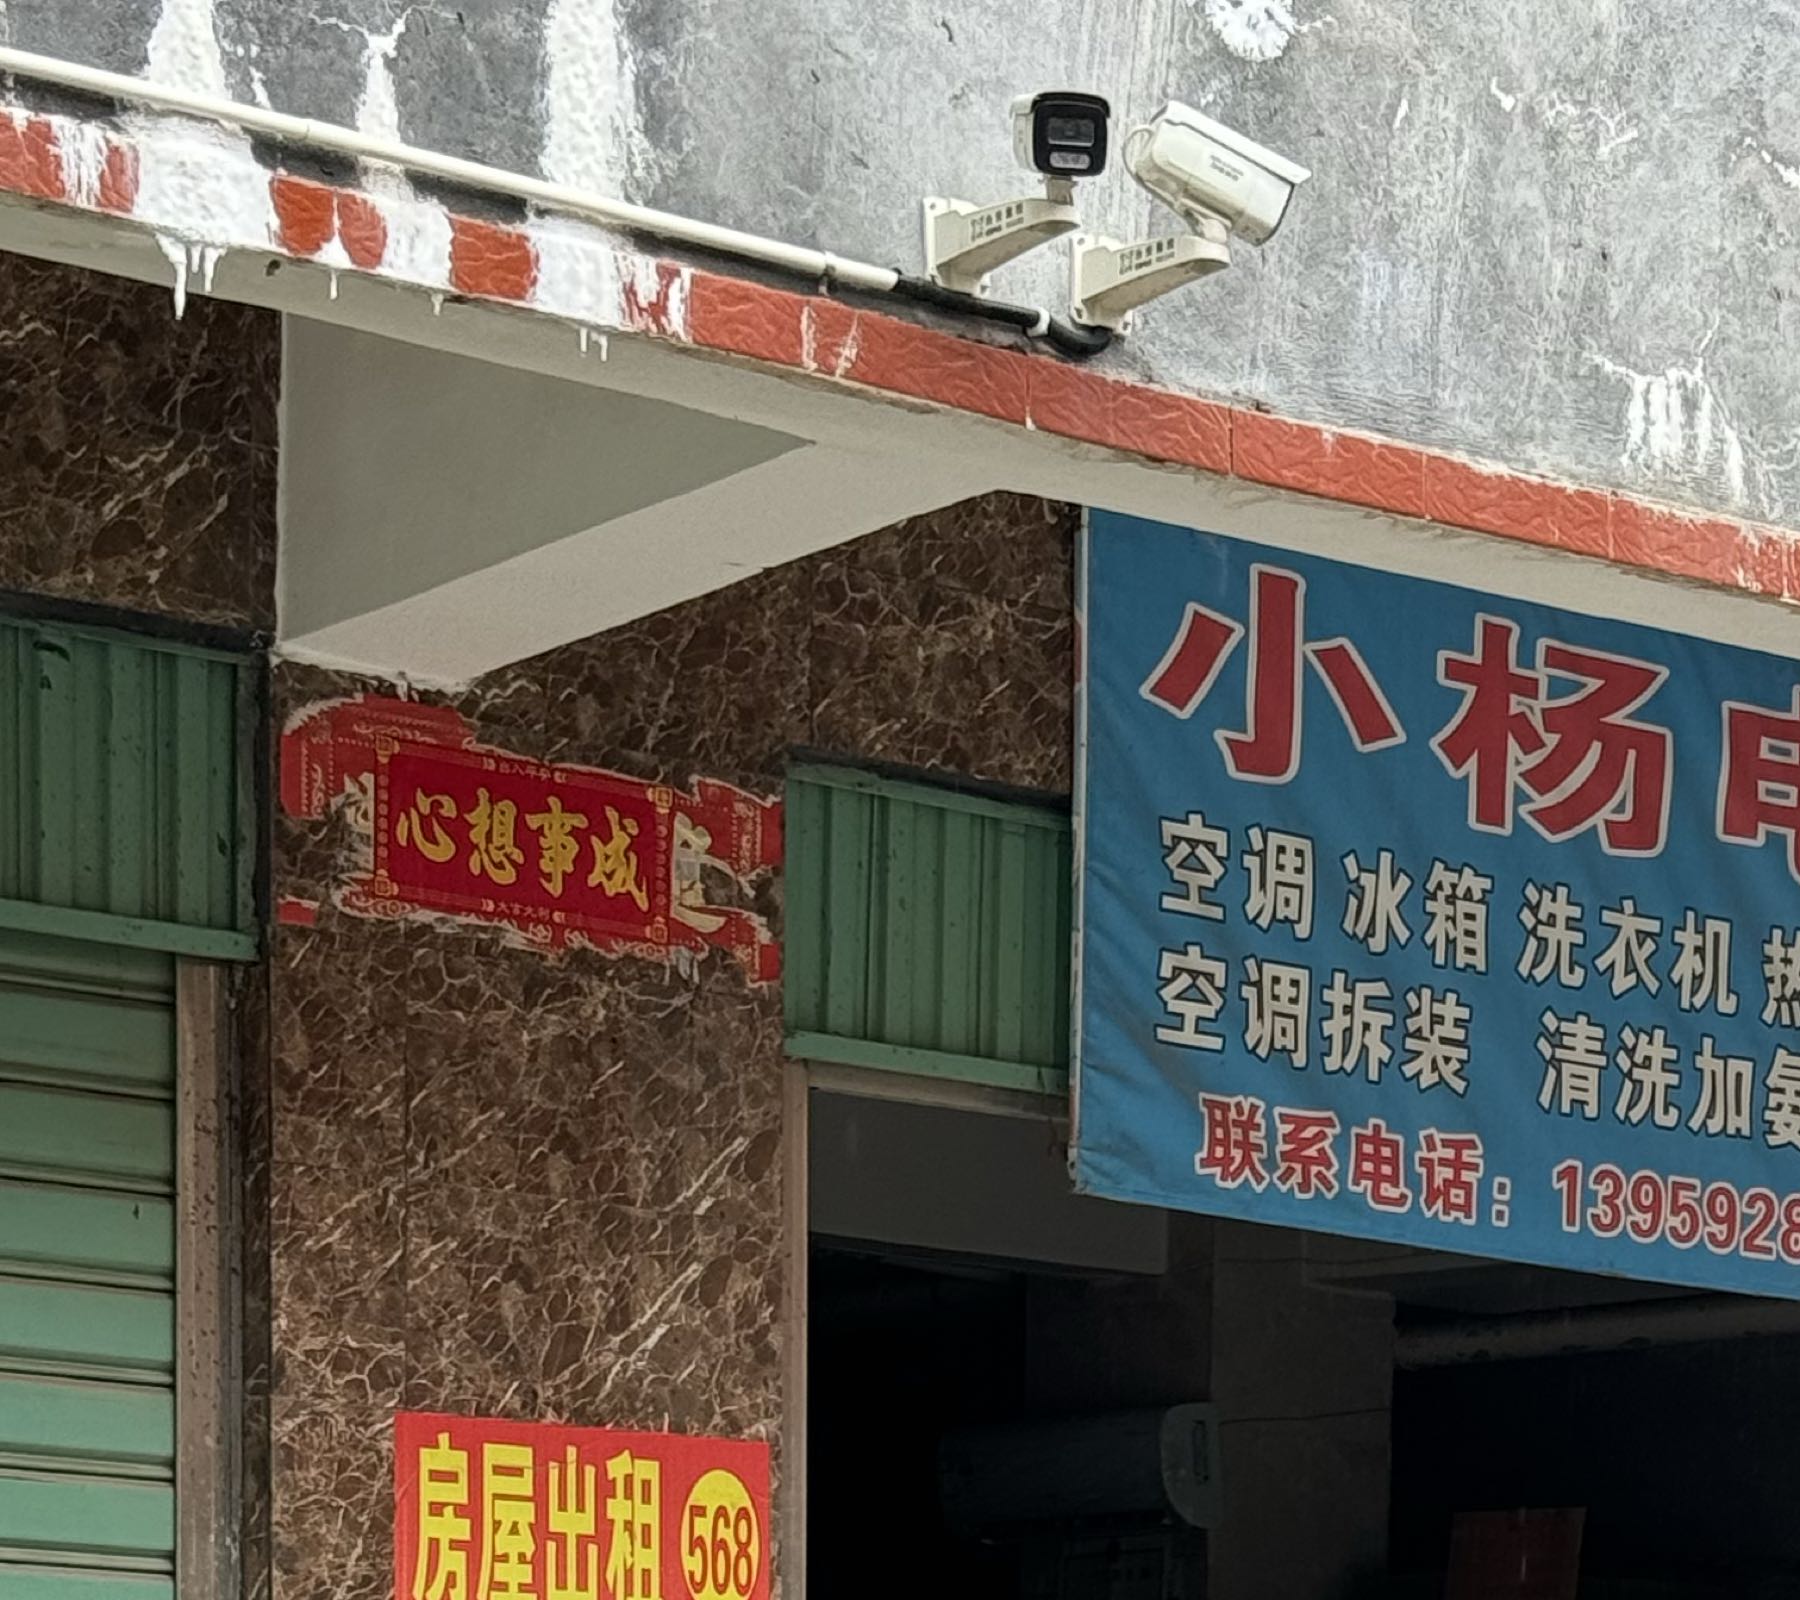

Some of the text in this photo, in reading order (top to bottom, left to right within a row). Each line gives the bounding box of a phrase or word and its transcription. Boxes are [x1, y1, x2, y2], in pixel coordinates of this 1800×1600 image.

[397, 787, 649, 912] 心想事成
[1159, 813, 1314, 939] 空调
[1342, 848, 1493, 974] 冰箱
[1515, 881, 1739, 1018] 洗衣机
[1155, 945, 1473, 1097] 空调拆装
[1195, 1093, 1511, 1228] 联系电话：
[686, 1504, 754, 1596] 568
